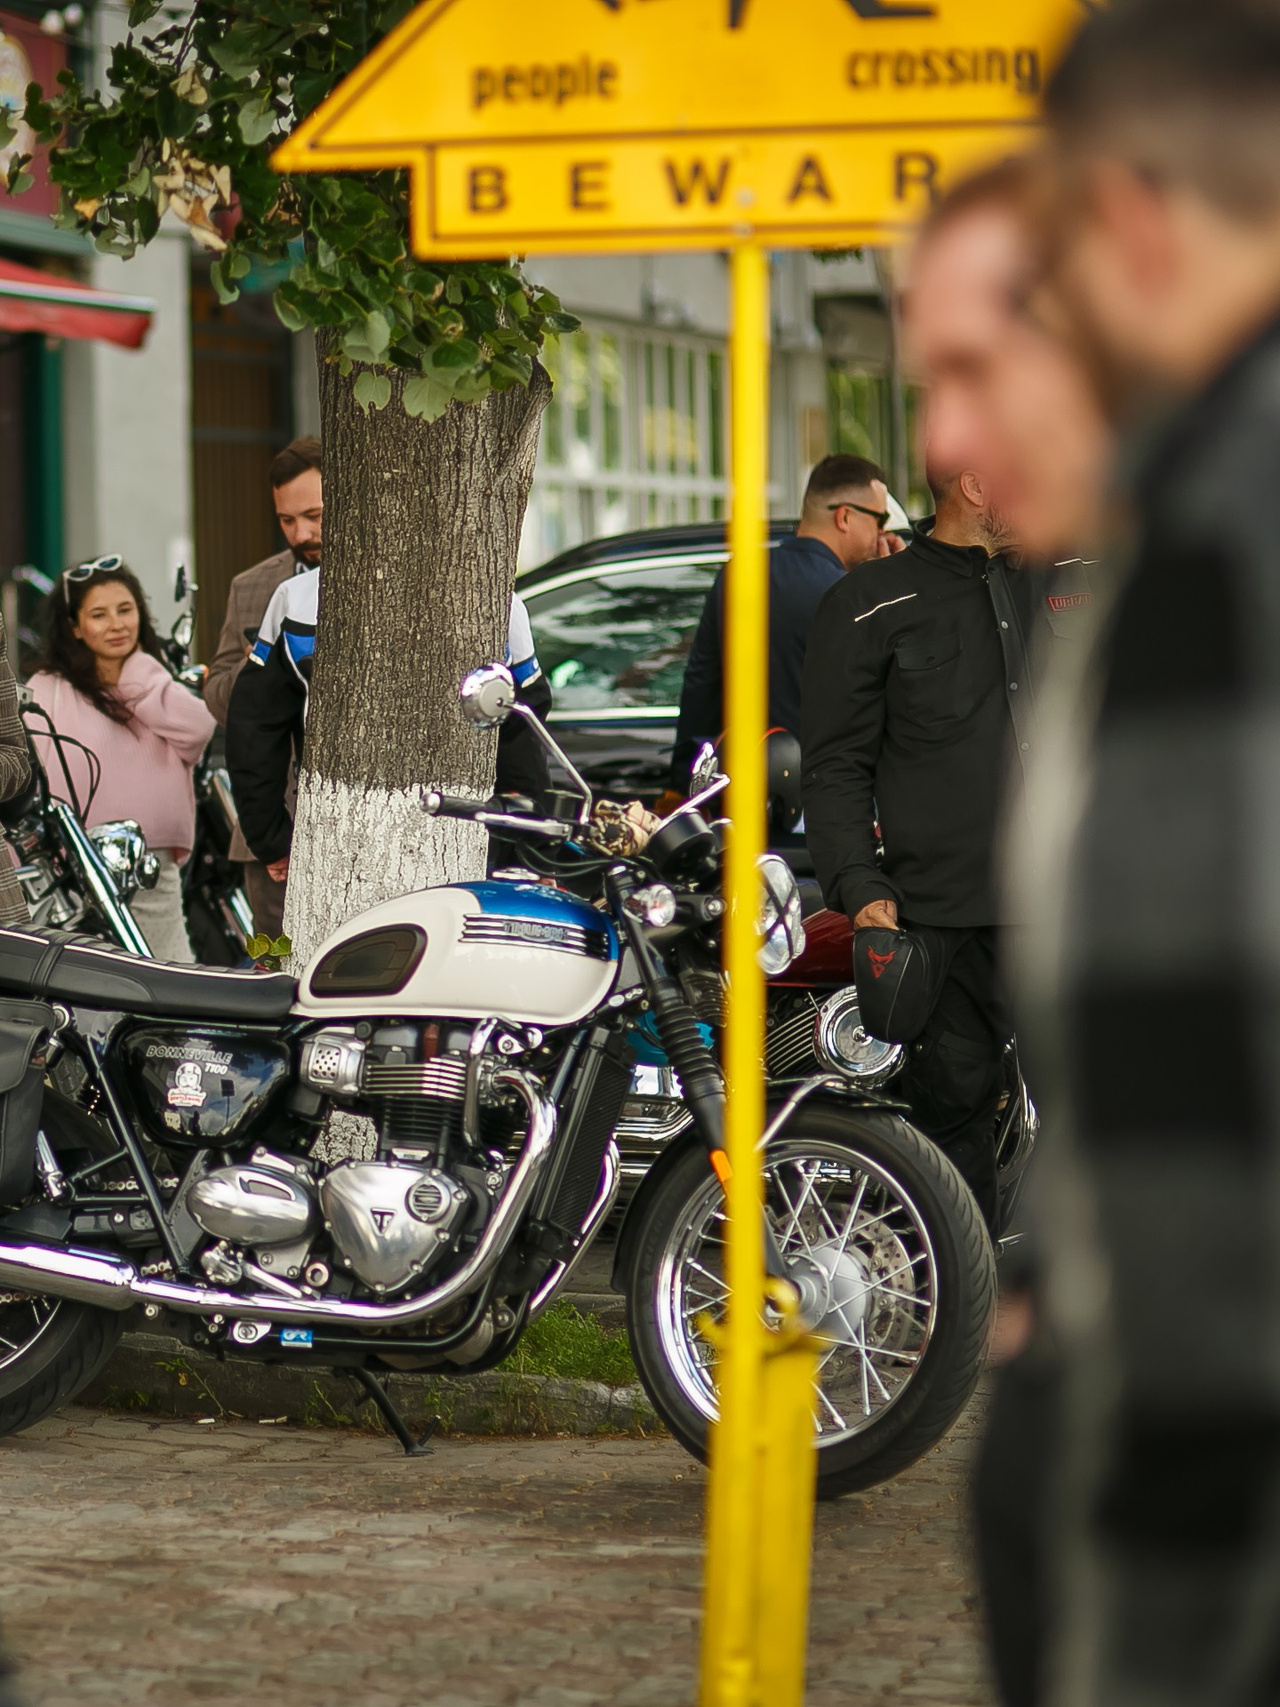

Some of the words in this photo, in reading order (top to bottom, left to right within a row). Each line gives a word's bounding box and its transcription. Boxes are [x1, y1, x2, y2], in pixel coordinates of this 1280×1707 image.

[472, 54, 617, 110] people
[846, 46, 1042, 97] crossing
[467, 151, 939, 214] BEWAR
[503, 921, 568, 942] TRIUMPH
[146, 1045, 233, 1065] BONNEVILLE
[204, 1062, 228, 1075] T100
